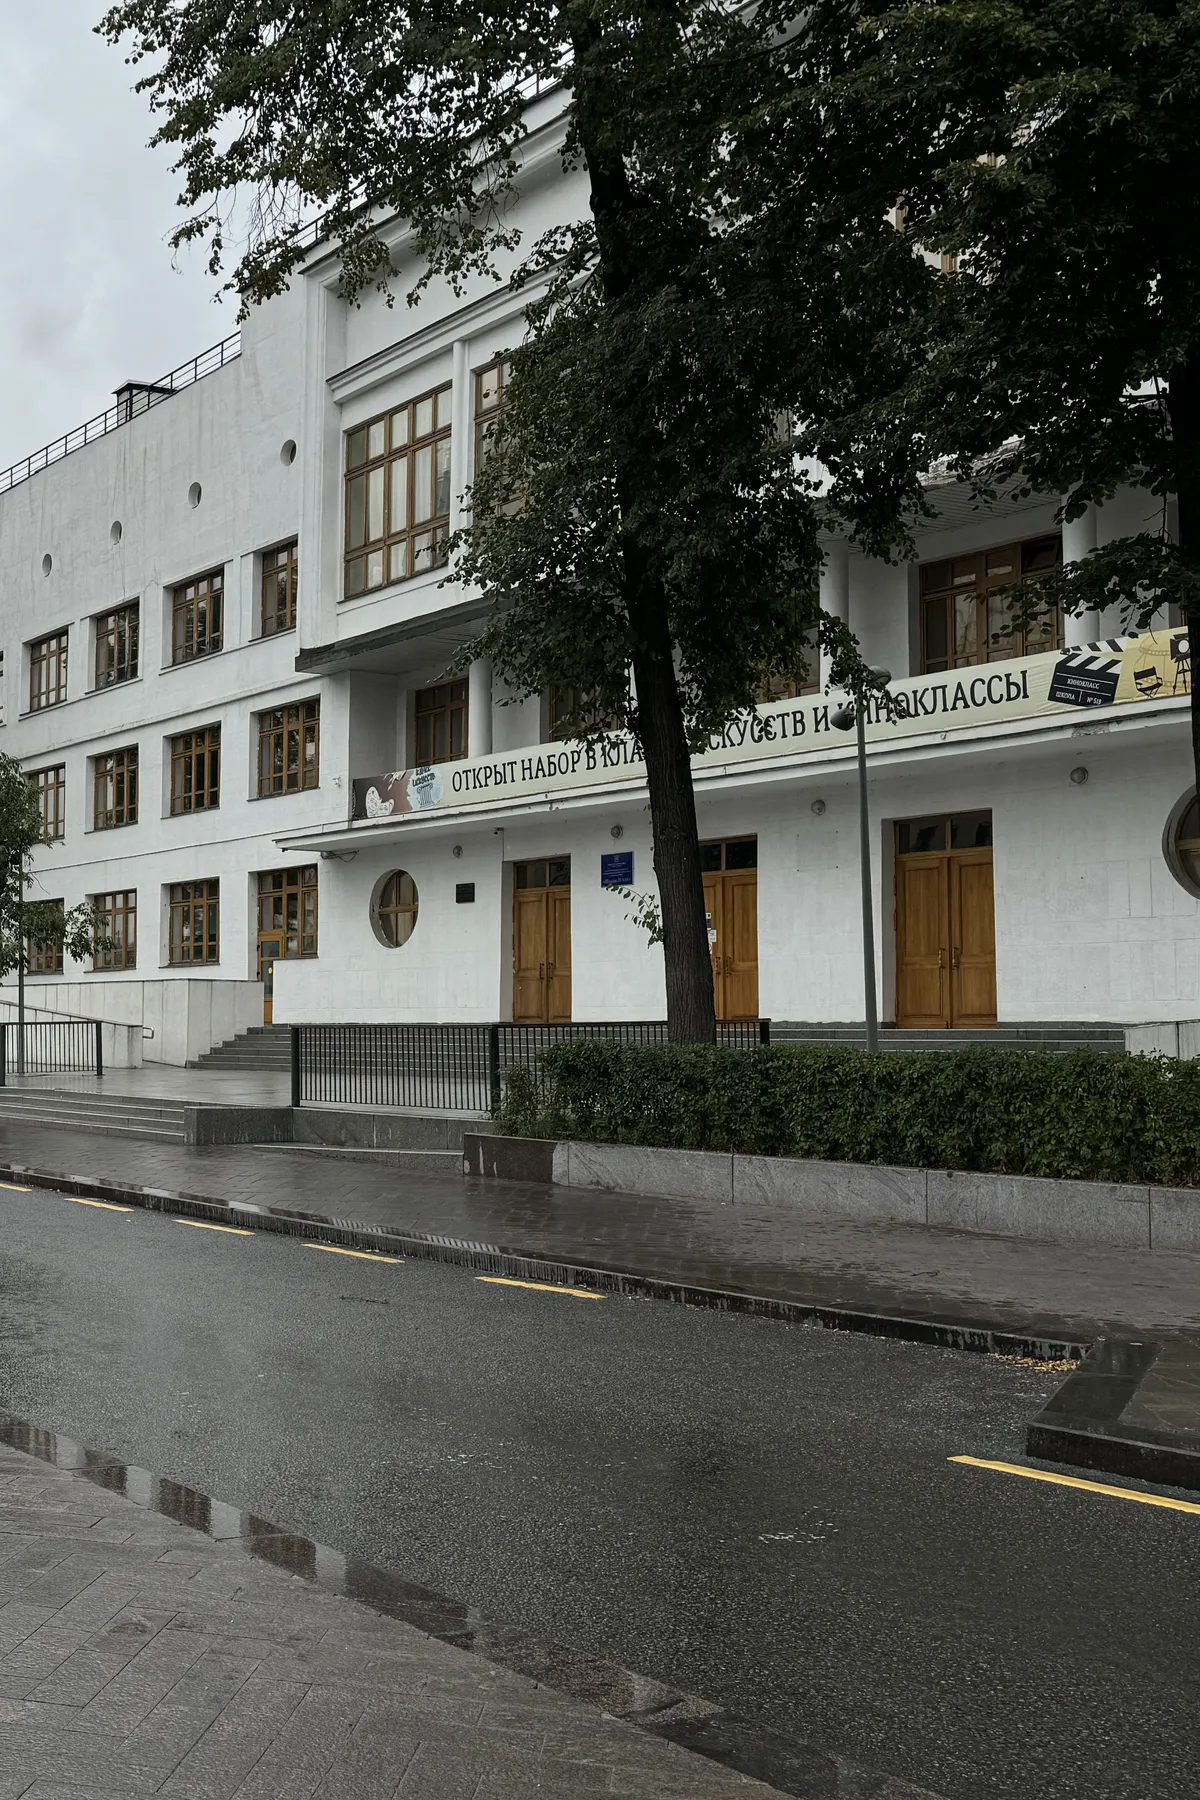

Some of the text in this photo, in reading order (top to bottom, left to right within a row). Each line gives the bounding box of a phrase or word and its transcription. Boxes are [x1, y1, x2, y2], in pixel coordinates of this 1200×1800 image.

[1067, 678, 1100, 689] КИНОКЛАСС
[1055, 691, 1076, 700] ШКОЛА
[452, 761, 517, 792] ОТКРЫТ
[521, 750, 580, 781] НАБОР
[586, 746, 597, 770] В
[602, 739, 645, 767] КЛА
[707, 710, 806, 750] СКУССТВ
[812, 706, 831, 733] И
